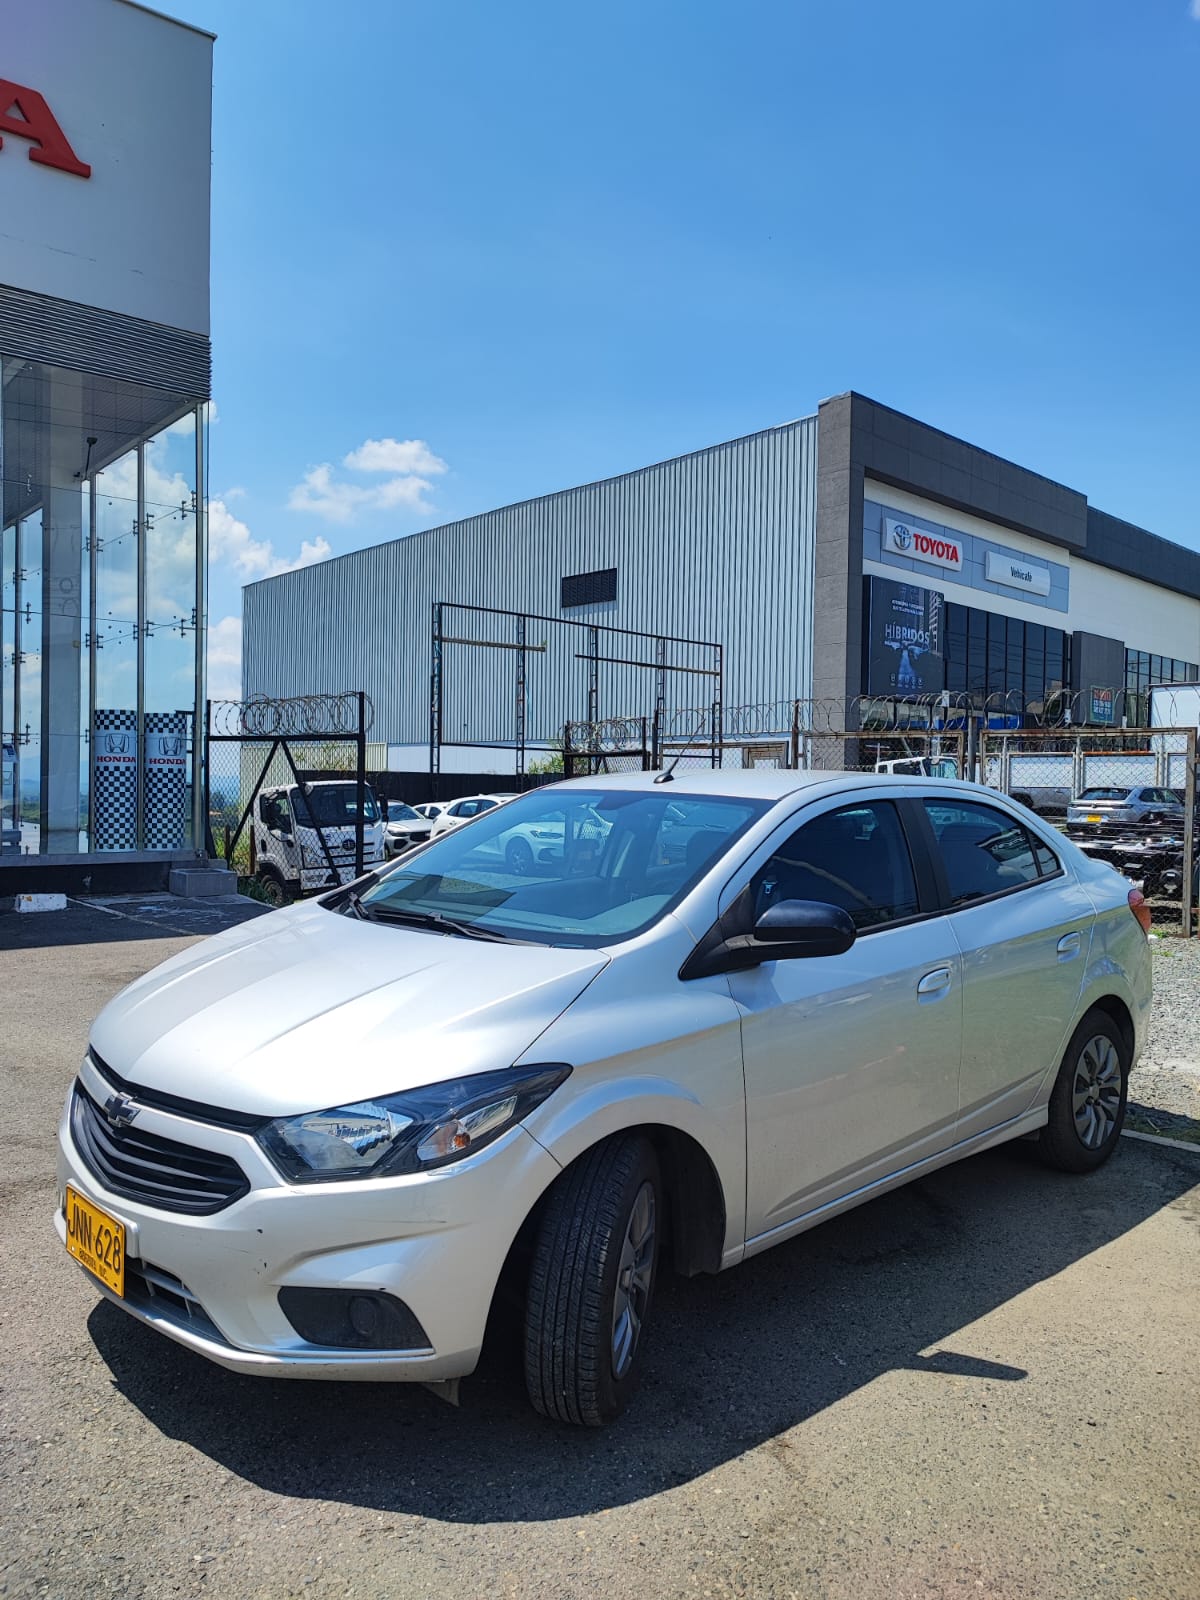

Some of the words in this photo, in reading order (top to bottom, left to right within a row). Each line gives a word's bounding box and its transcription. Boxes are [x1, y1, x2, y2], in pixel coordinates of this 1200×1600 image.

[913, 533, 959, 563] TOYOTA
[67, 1203, 92, 1254] JNN
[95, 1224, 121, 1274] 628
